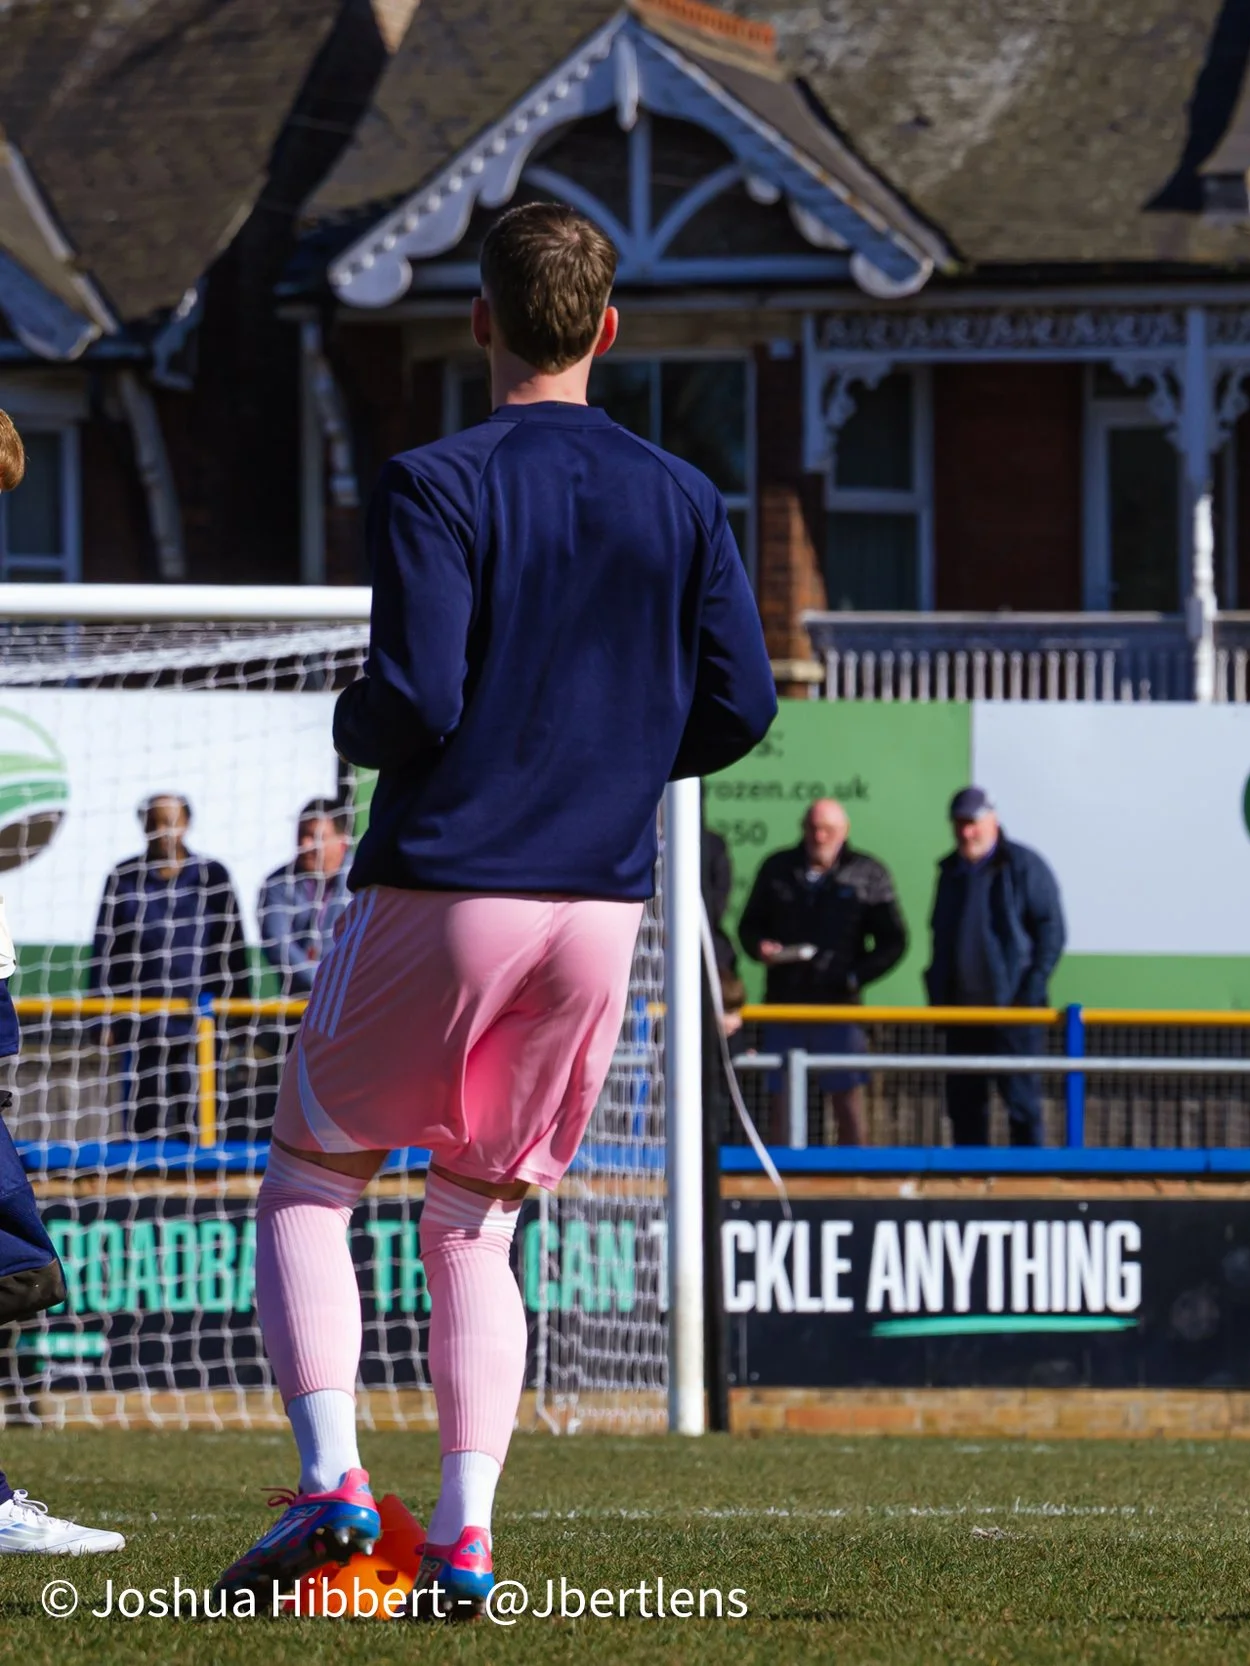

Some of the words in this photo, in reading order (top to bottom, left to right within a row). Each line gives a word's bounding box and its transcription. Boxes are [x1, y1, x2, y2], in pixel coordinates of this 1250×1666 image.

[47, 1220, 257, 1313] ROADBA
[524, 1220, 636, 1312] CAN
[650, 1220, 853, 1313] TCKLE
[866, 1220, 1142, 1313] ANYTHING
